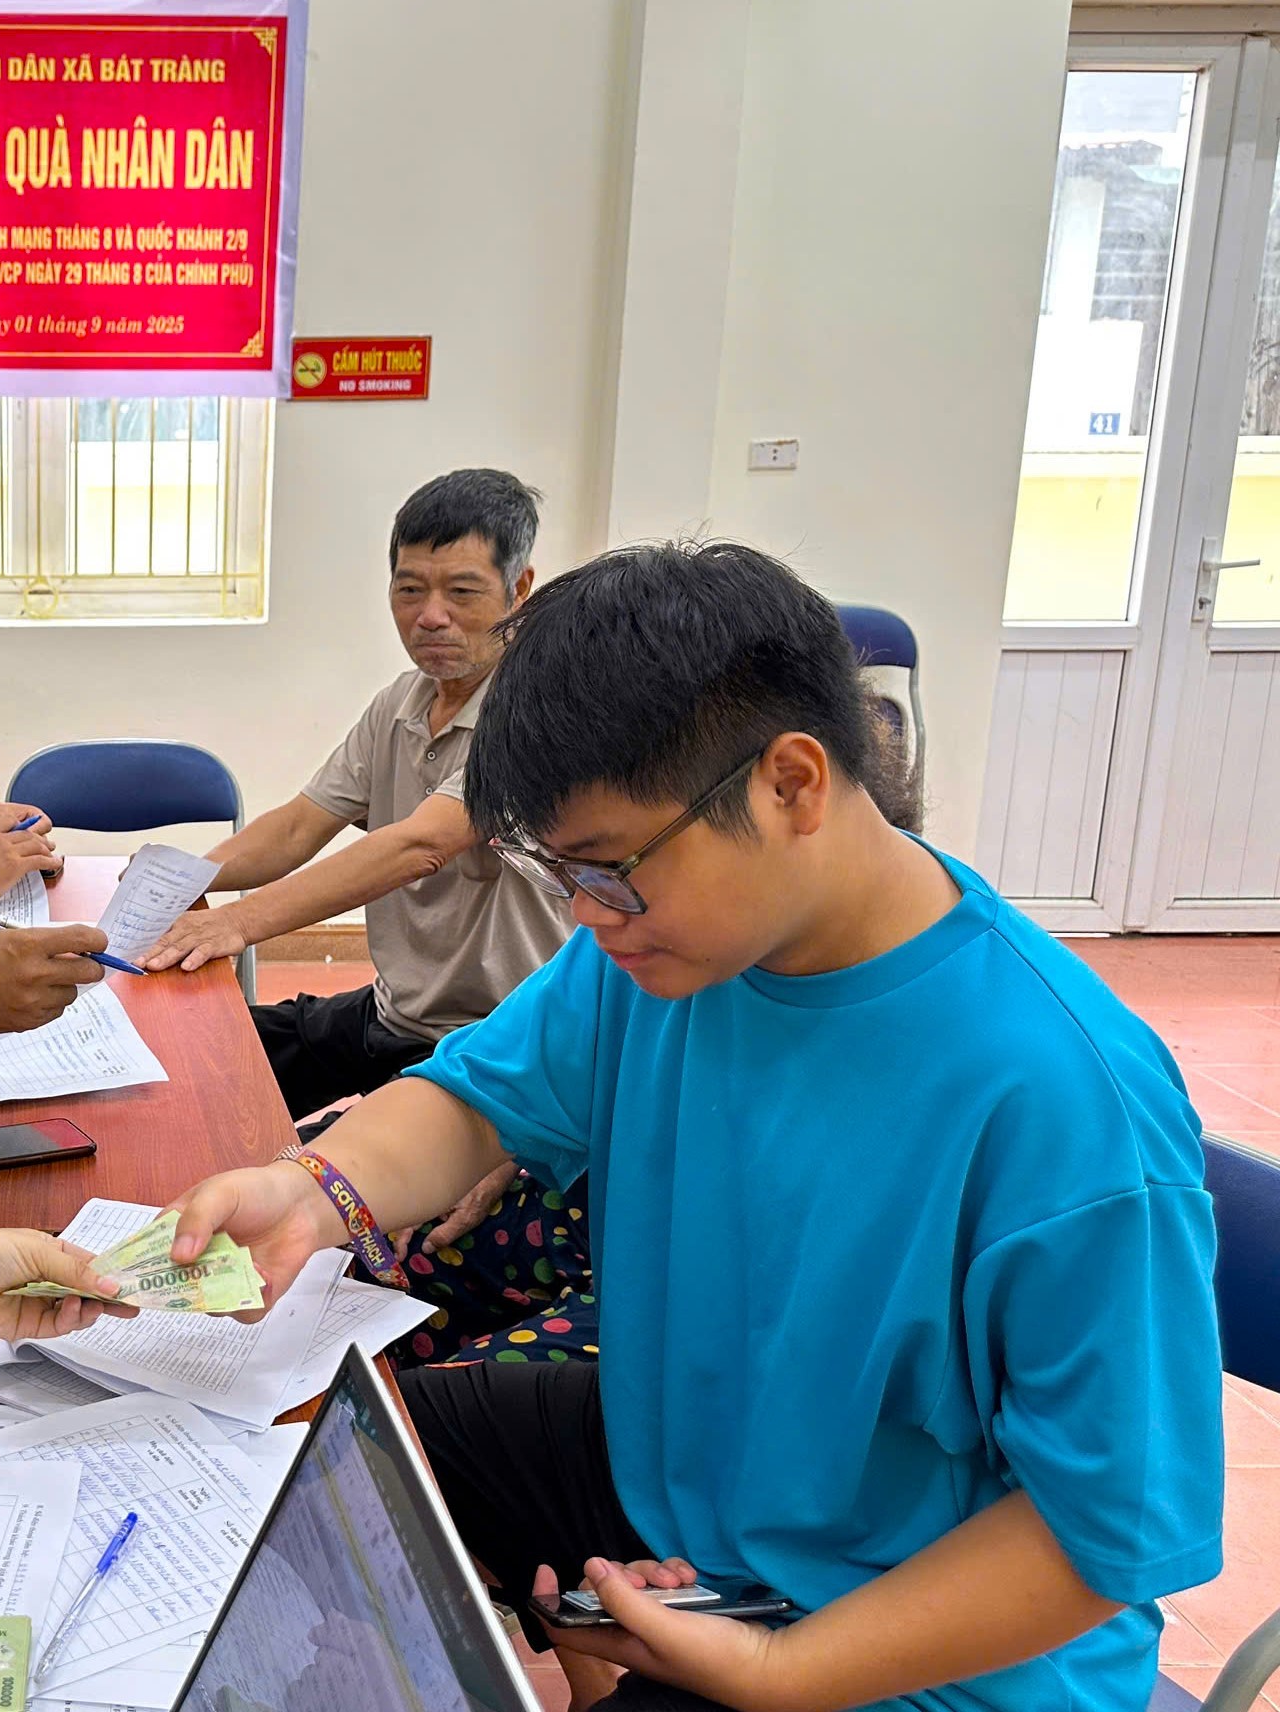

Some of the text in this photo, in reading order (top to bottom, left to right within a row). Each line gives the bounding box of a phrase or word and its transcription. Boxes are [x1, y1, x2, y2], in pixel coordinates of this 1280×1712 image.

[8, 53, 56, 82] DÂN
[62, 53, 94, 82] XÃ
[100, 53, 144, 82] BÁT
[150, 54, 226, 83] TRÀNG
[5, 114, 72, 196] QUÀ
[81, 115, 176, 190] NHÂN
[184, 116, 254, 190] DÂN
[11, 225, 51, 253] MẠNG
[55, 223, 100, 250] THÁNG
[102, 228, 112, 250] 8
[115, 223, 133, 250] VÀ
[136, 220, 173, 253] QUỐC
[176, 223, 223, 251] KHÁNH
[225, 229, 249, 251] 2/9
[25, 257, 62, 285] NGÀY
[65, 262, 83, 285] 29
[86, 258, 130, 285] THÁNG
[133, 263, 143, 286] 8
[145, 253, 171, 286] CỦA
[176, 258, 218, 286] CHÍNH
[221, 254, 254, 287] PHỦ)
[14, 315, 33, 333] 01
[38, 314, 87, 338] tháng
[91, 316, 102, 333] 9
[105, 317, 142, 333] năm
[146, 316, 184, 334] 2025
[332, 343, 423, 373] CẤM HÚT THUỐC
[339, 379, 412, 392] NO SMOKING
[1093, 414, 1113, 433] 41
[329, 1180, 360, 1220] SƠN
